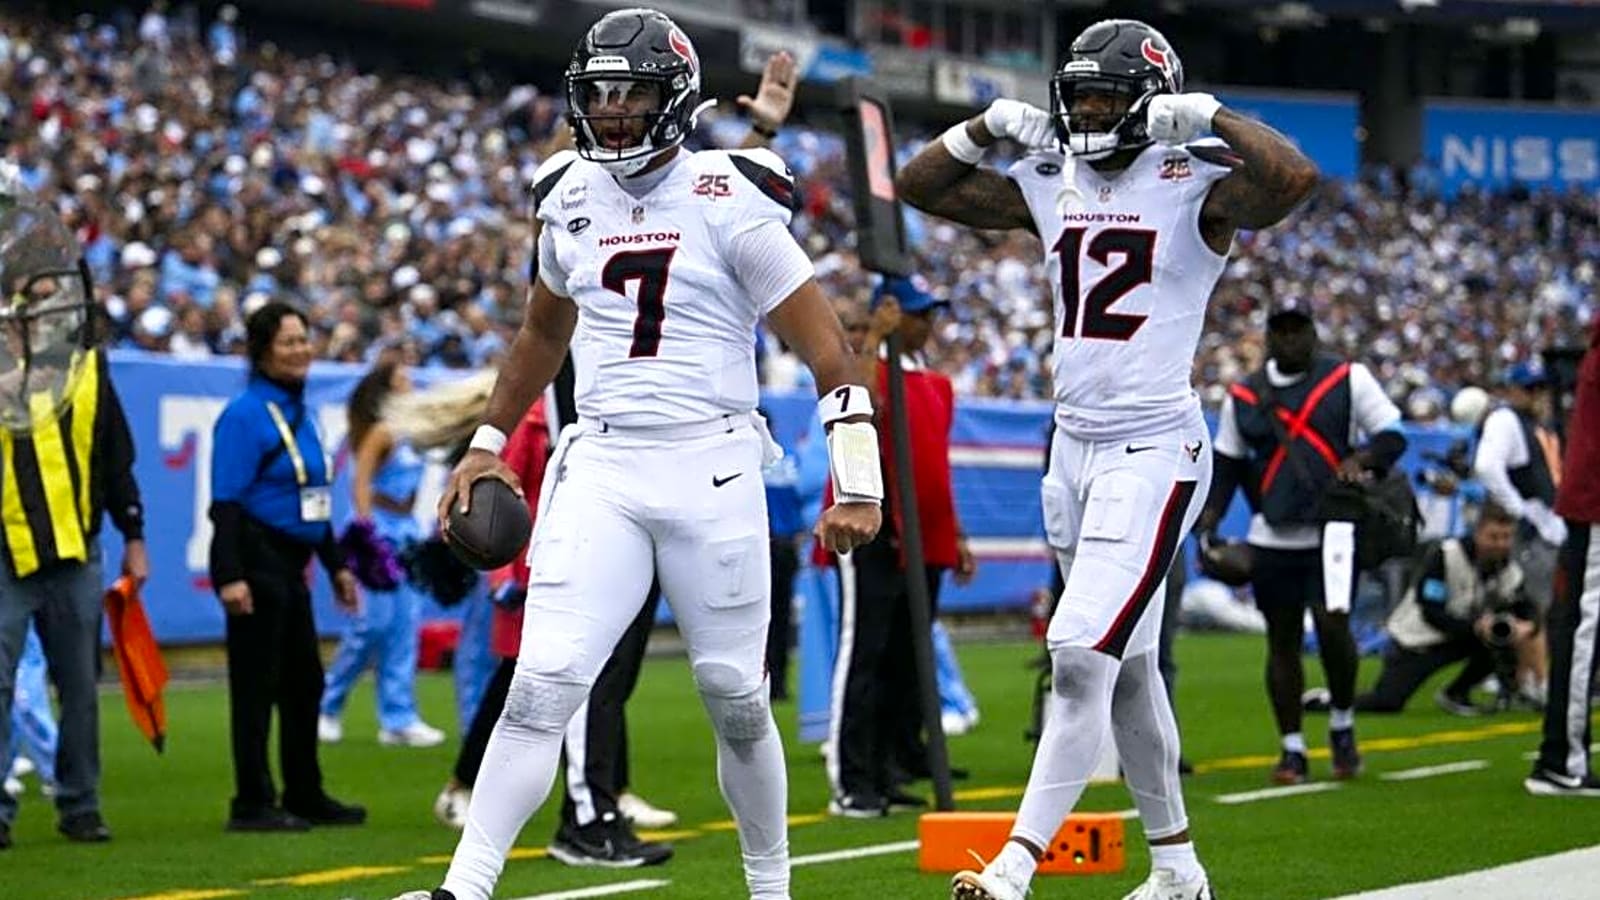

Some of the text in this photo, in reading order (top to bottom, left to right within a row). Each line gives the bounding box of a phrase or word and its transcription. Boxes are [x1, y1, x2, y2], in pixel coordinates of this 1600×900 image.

[1442, 134, 1599, 180] NISS
[1063, 213, 1141, 223] HOUSTON
[598, 232, 681, 247] HOUSTON
[1051, 227, 1158, 341] 12
[602, 247, 676, 357] 7
[835, 387, 850, 412] 7
